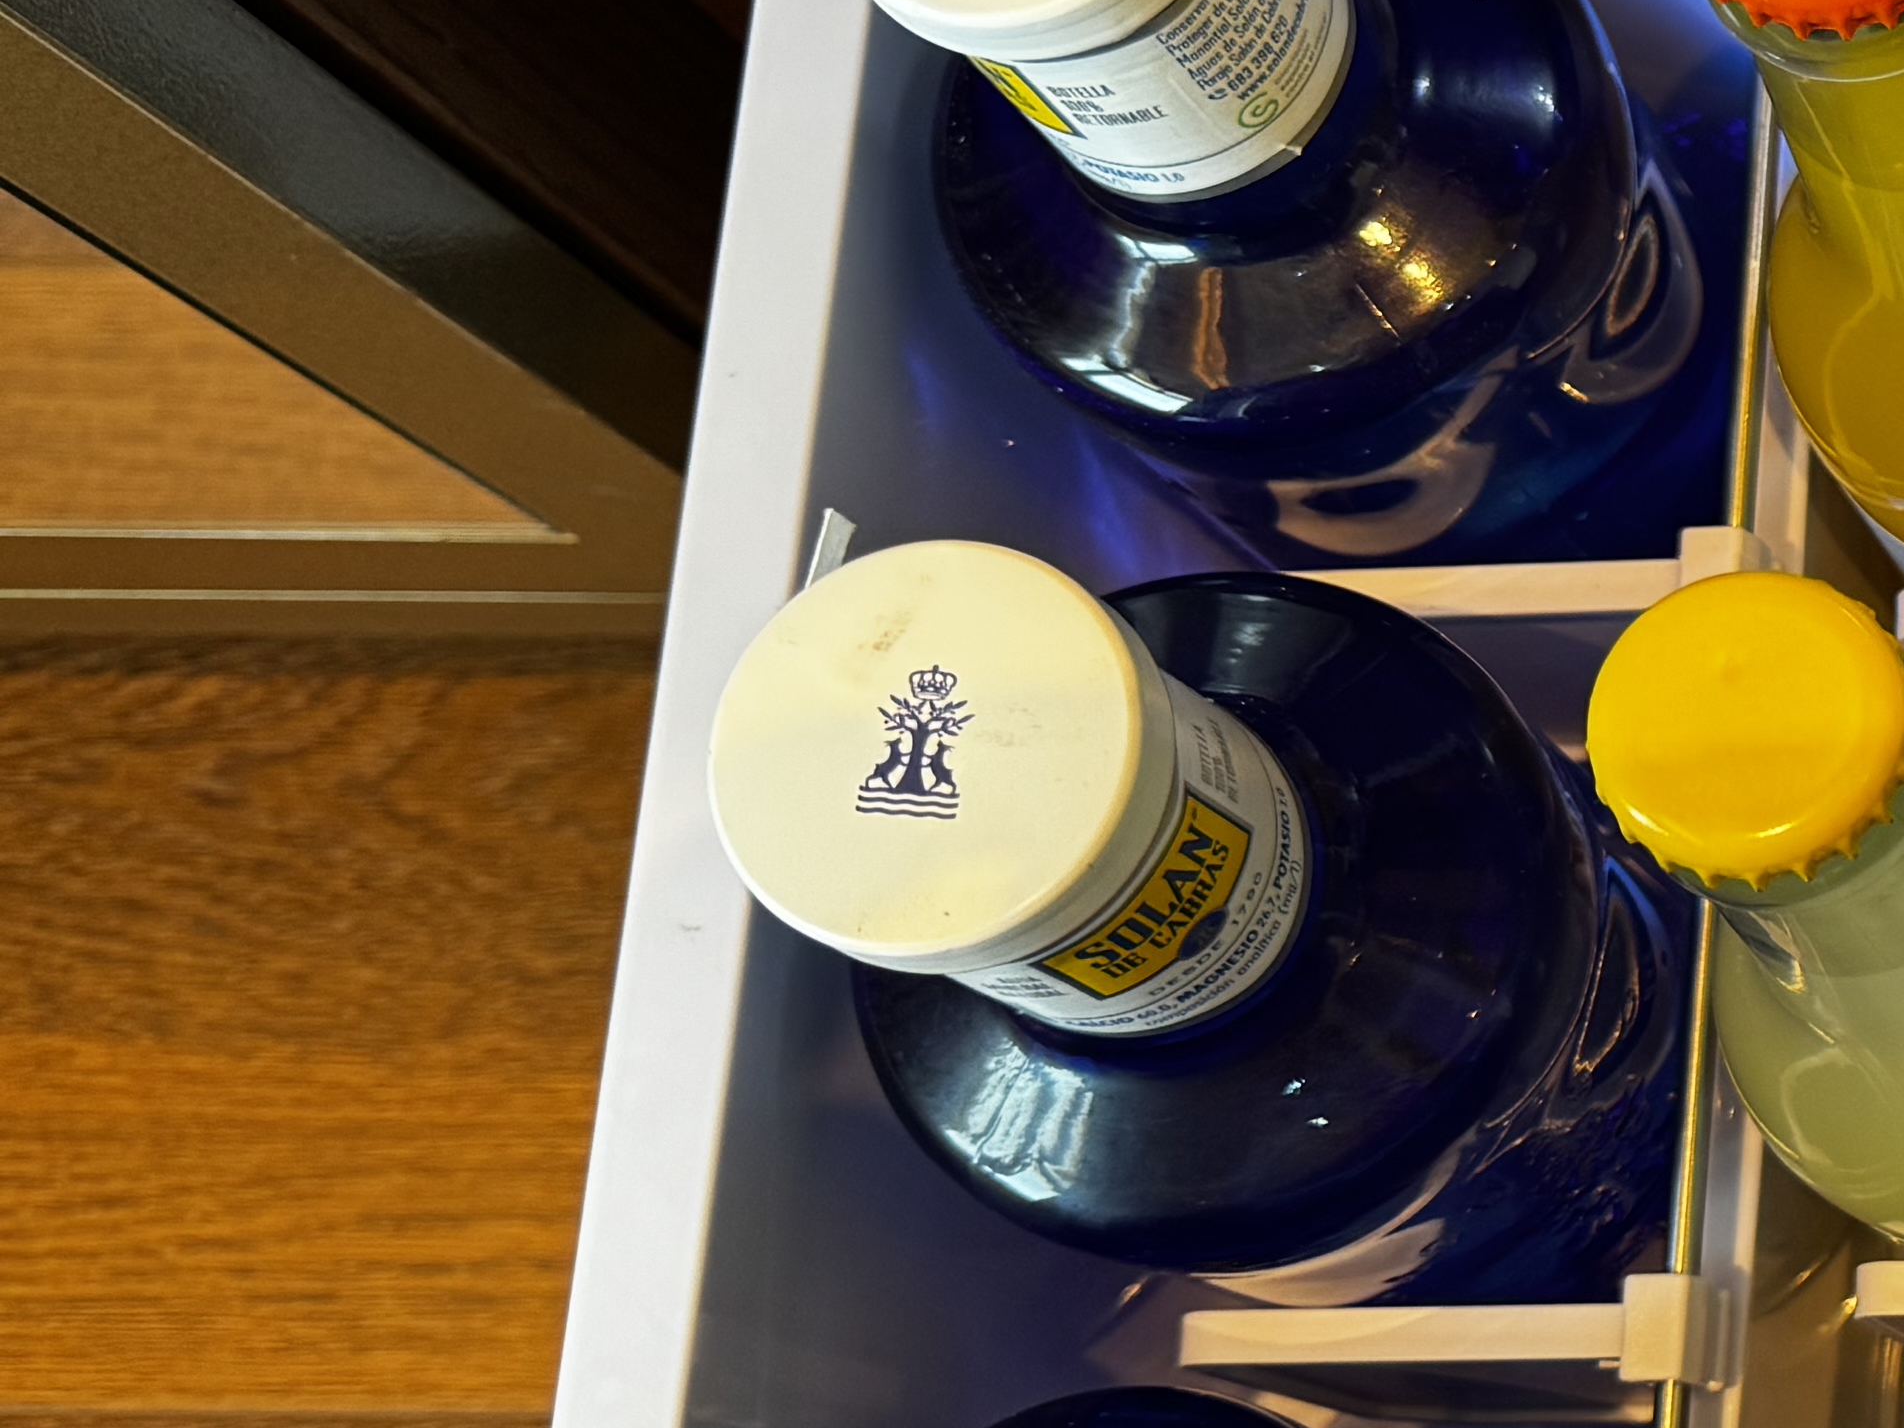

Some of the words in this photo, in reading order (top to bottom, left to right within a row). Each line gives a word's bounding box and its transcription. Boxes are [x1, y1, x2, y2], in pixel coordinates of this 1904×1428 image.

[1148, 839, 1230, 950] CABRAS
[1177, 929, 1260, 1004] MAGNESIO
[1275, 810, 1291, 890] POTASIO
